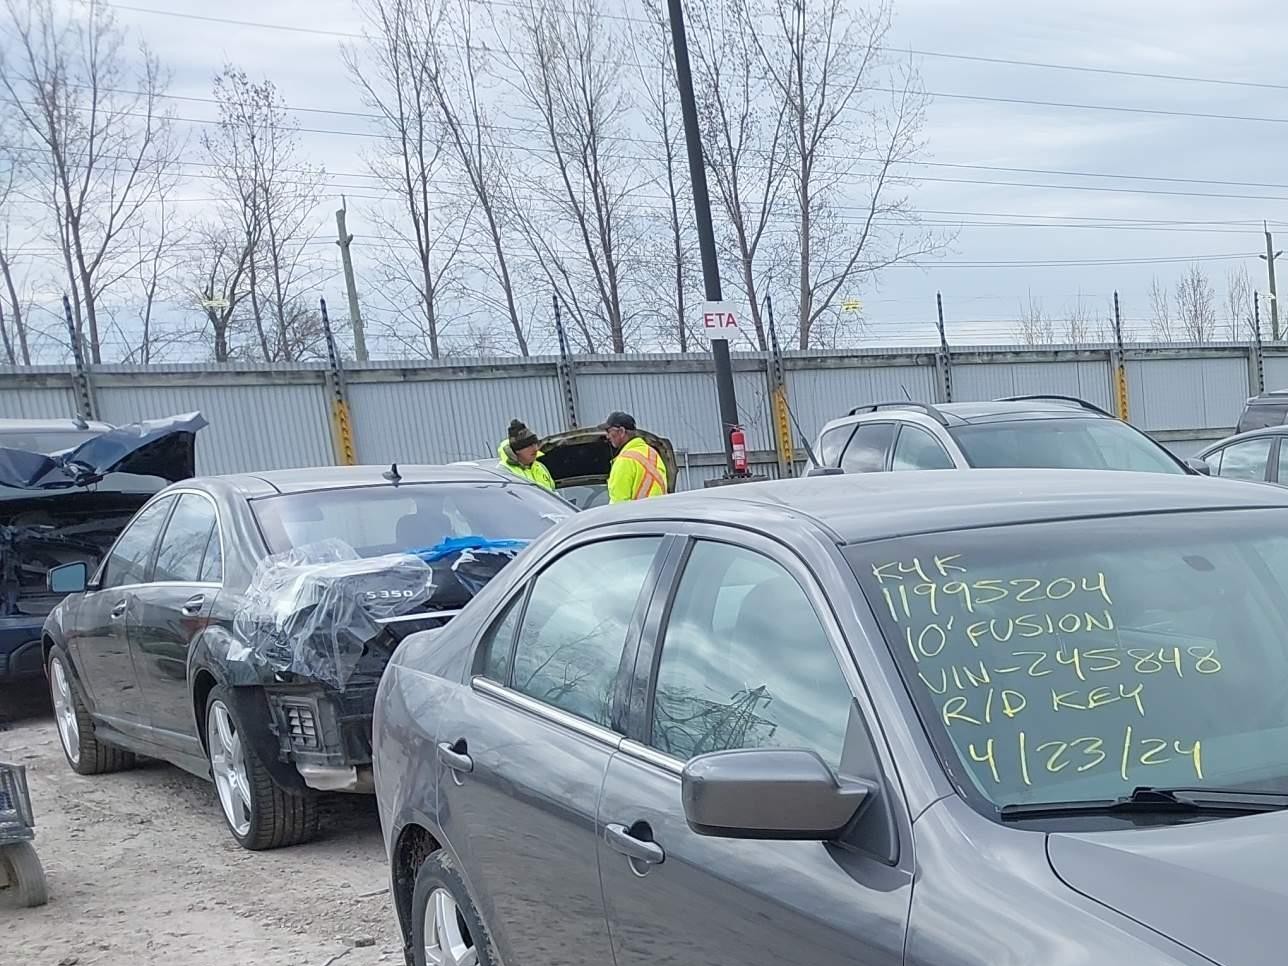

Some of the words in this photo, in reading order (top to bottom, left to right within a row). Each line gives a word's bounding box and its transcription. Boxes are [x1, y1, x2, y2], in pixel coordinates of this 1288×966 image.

[703, 313, 738, 328] ETA
[882, 572, 1113, 622] 11995204
[966, 609, 1114, 648] FUSION
[1051, 683, 1146, 717] KEY
[968, 726, 1204, 785] 4/23/24
